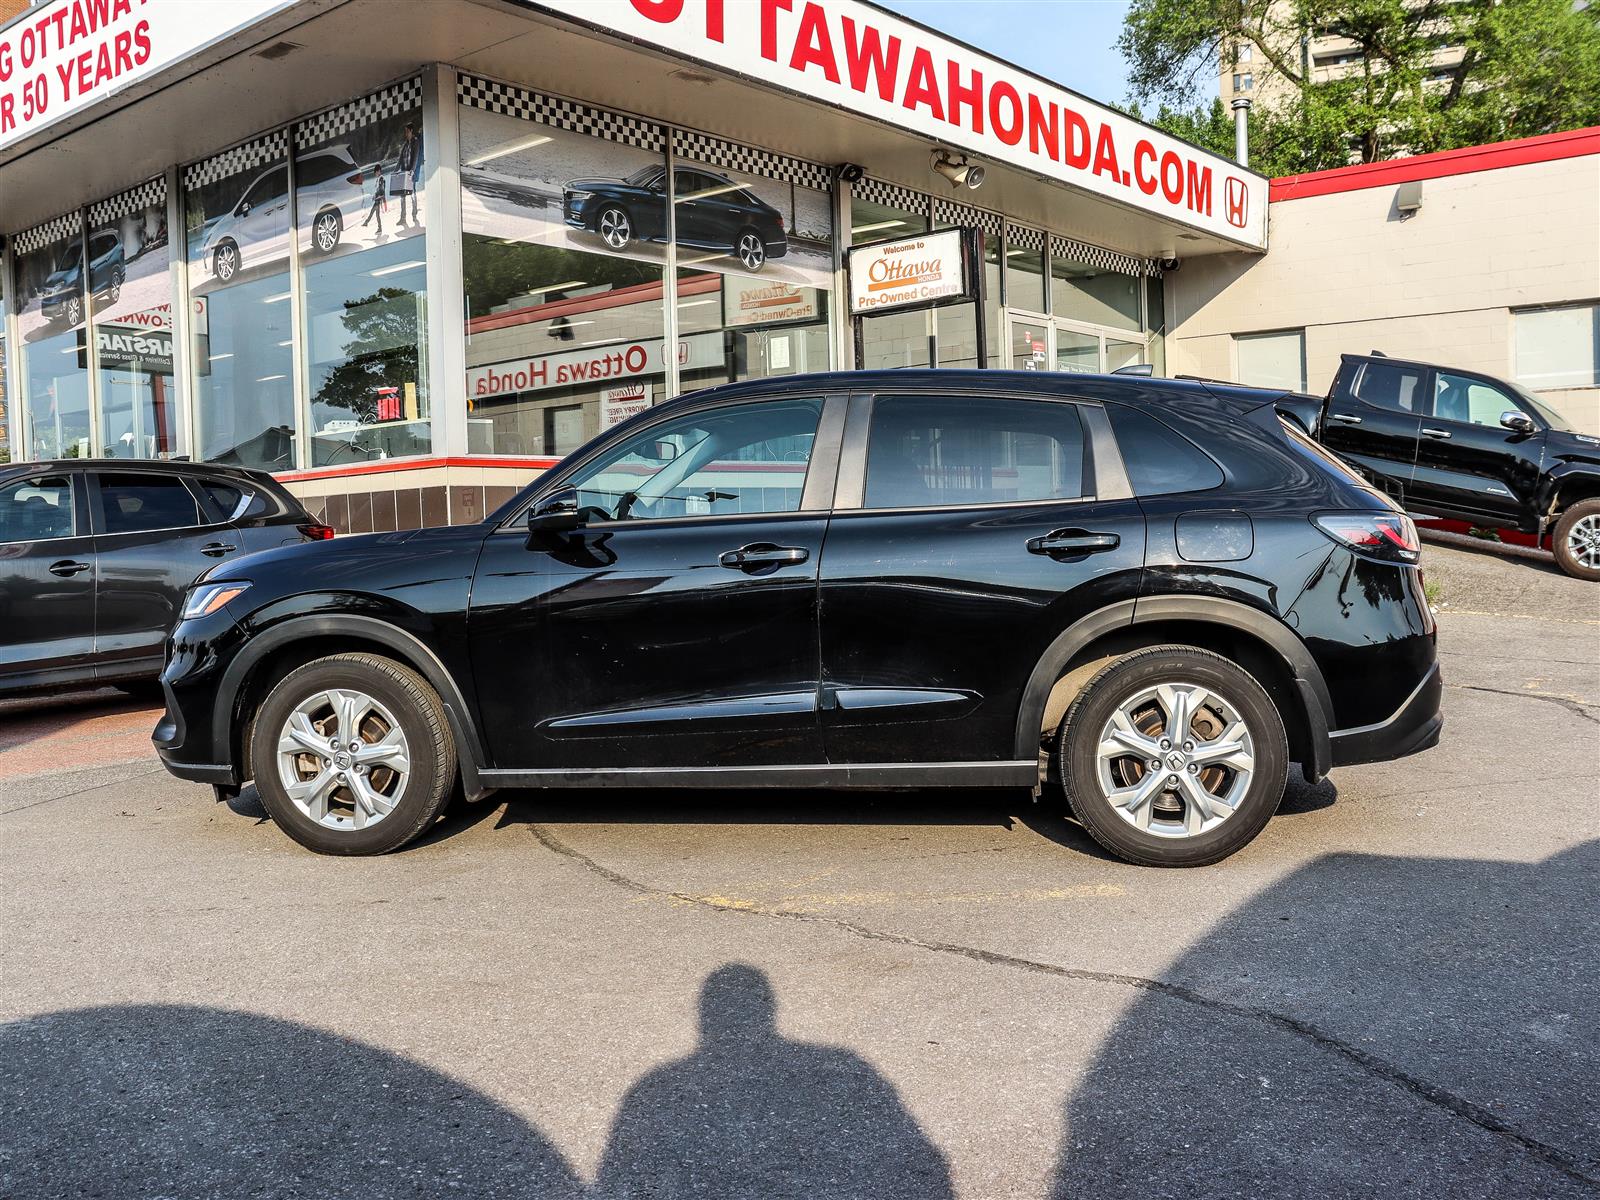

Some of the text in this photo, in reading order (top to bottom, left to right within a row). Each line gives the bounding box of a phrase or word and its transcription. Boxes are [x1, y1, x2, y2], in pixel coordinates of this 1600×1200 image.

[23, 73, 48, 122] 50
[56, 19, 151, 102] YEARS
[883, 241, 925, 255] Welcome to
[868, 258, 942, 283] Ottawa
[917, 273, 941, 283] HONDA
[859, 283, 958, 307] Pre-Owned Centre
